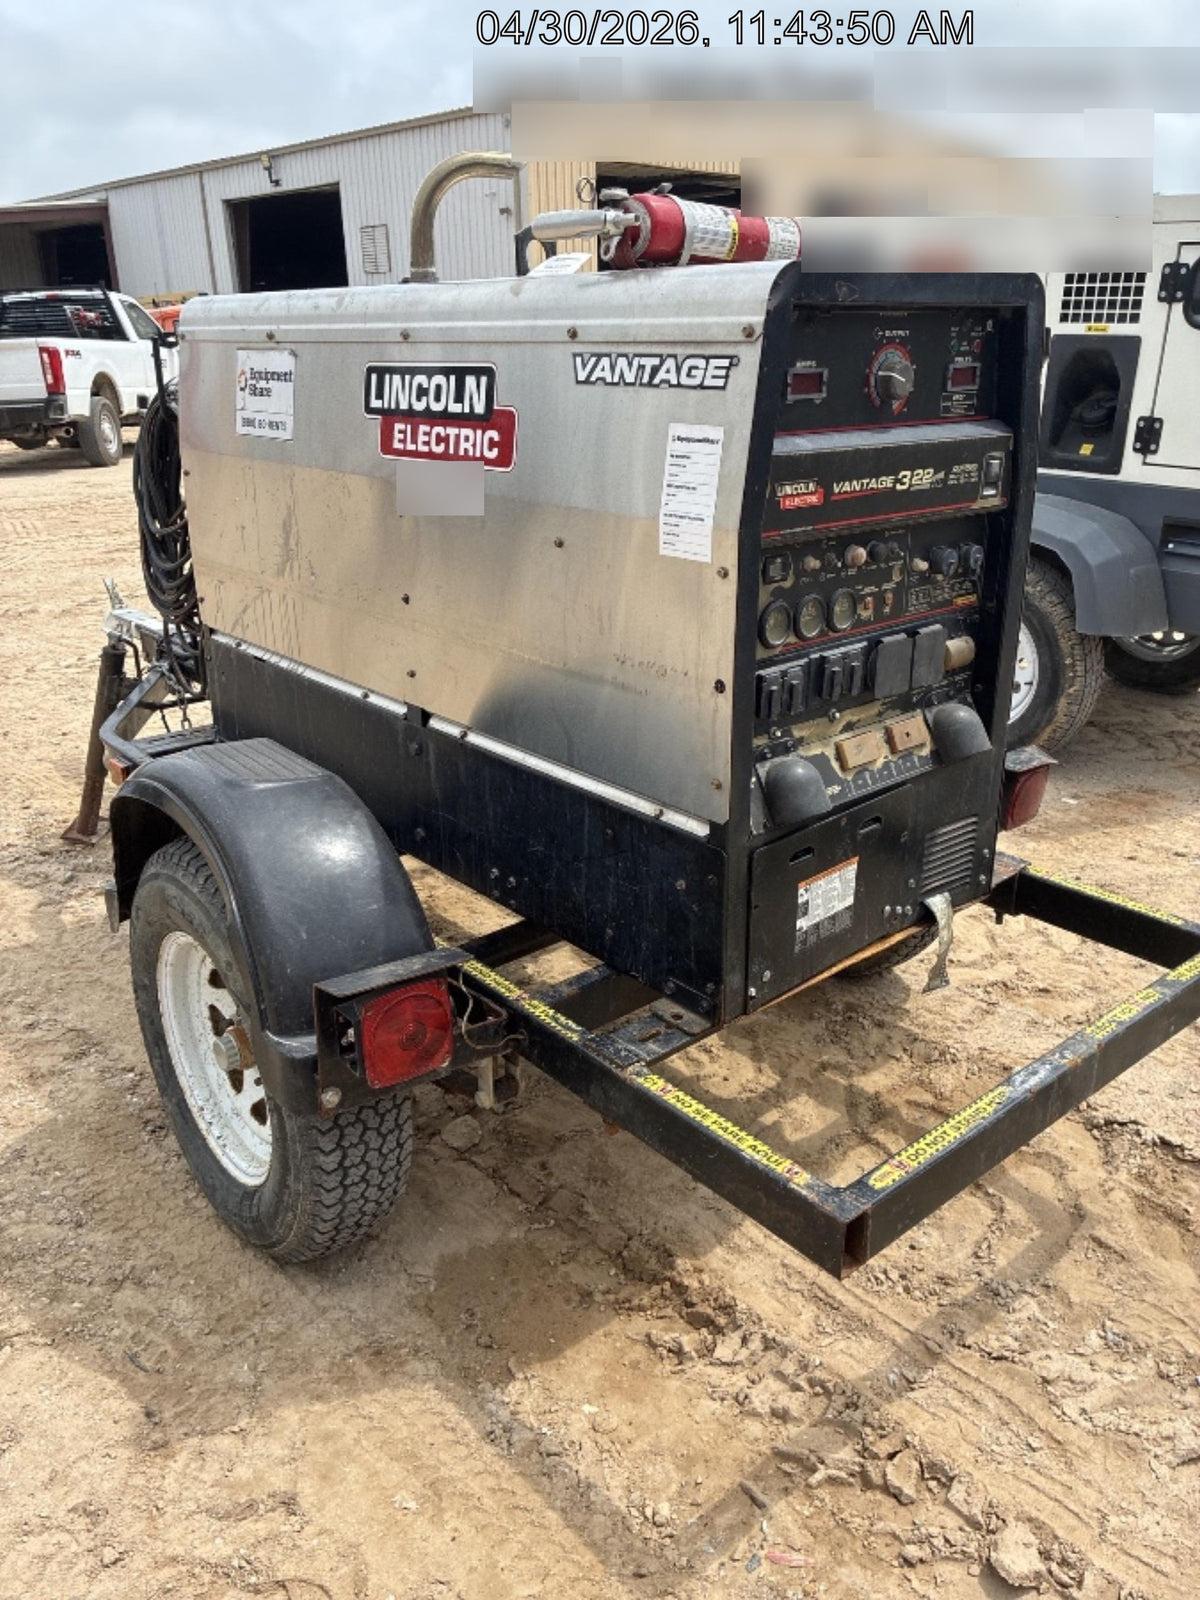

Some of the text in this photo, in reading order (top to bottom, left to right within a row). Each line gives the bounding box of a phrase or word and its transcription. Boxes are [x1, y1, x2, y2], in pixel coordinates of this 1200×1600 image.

[574, 354, 733, 389] VANTAGE
[369, 372, 489, 415] LINCOLN
[392, 422, 501, 459] ELECTRIC
[775, 480, 818, 497] LINCOLN
[833, 476, 896, 494] VANTAGE
[896, 467, 935, 491] 322
[670, 1093, 694, 1109] NO
[906, 1146, 928, 1162] DO
[925, 1128, 953, 1149] NOT
